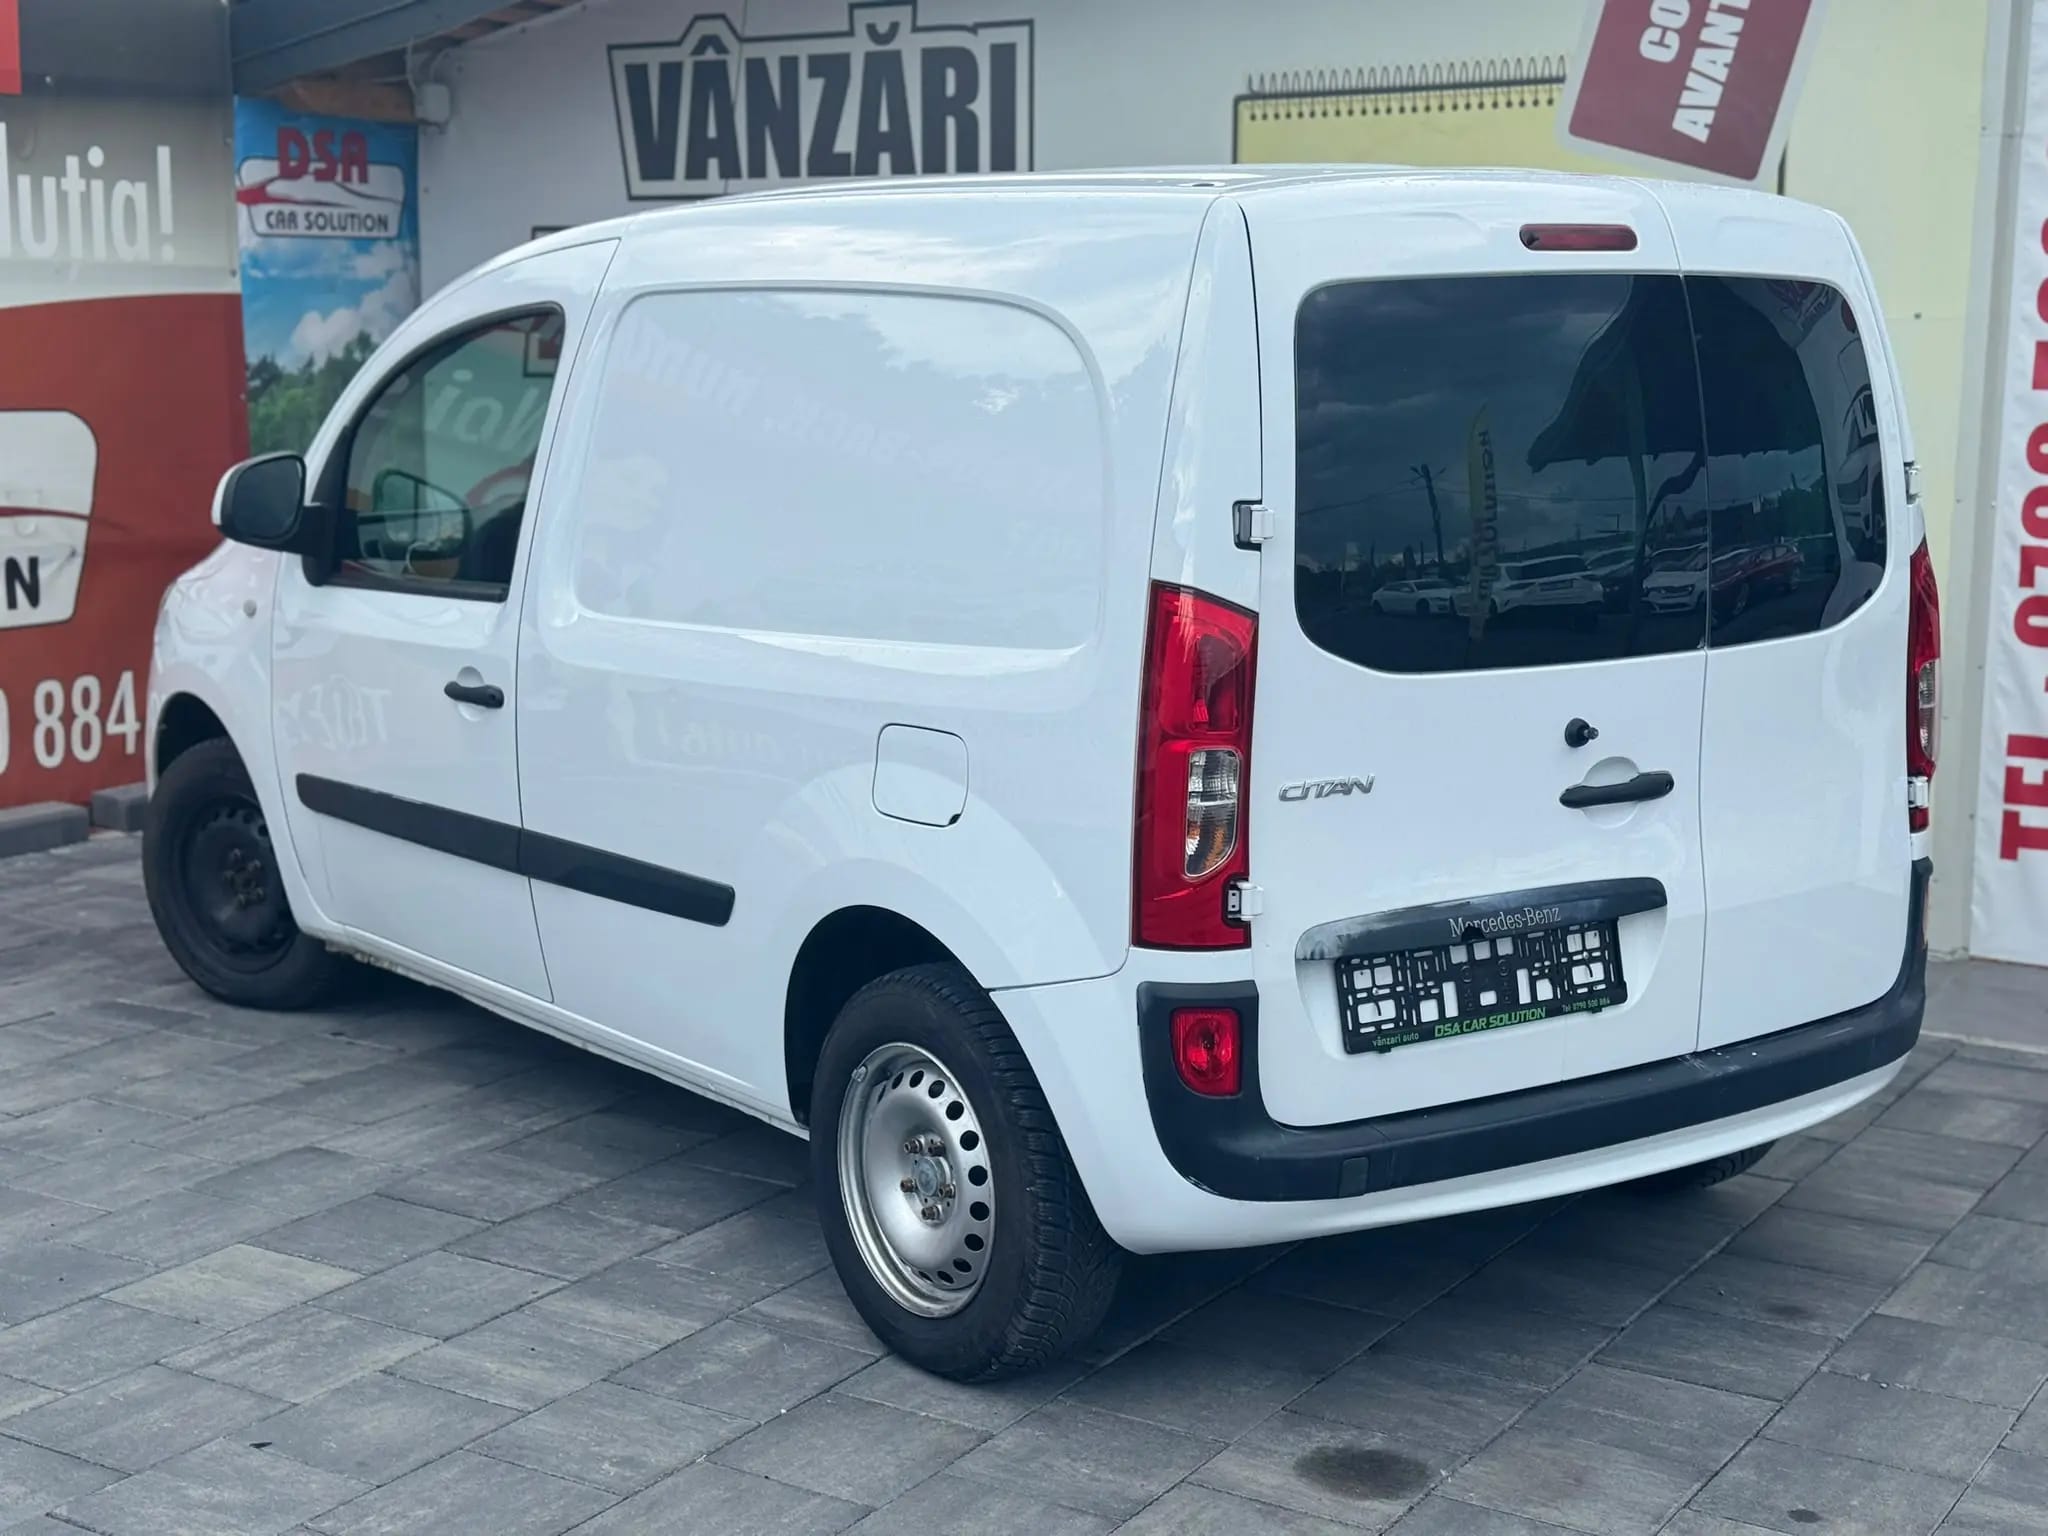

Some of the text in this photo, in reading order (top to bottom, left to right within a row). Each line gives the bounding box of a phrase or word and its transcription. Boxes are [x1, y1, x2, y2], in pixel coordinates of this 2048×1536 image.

[624, 21, 1018, 181] VÂNZĂRI
[277, 126, 369, 185] DSA
[265, 210, 389, 233] CAR SOLUTION
[33, 670, 142, 770] 884
[1278, 773, 1376, 802] CITAN
[1402, 1031, 1420, 1042] auto
[1434, 1006, 1547, 1038] DSA CAR SOLUTION
